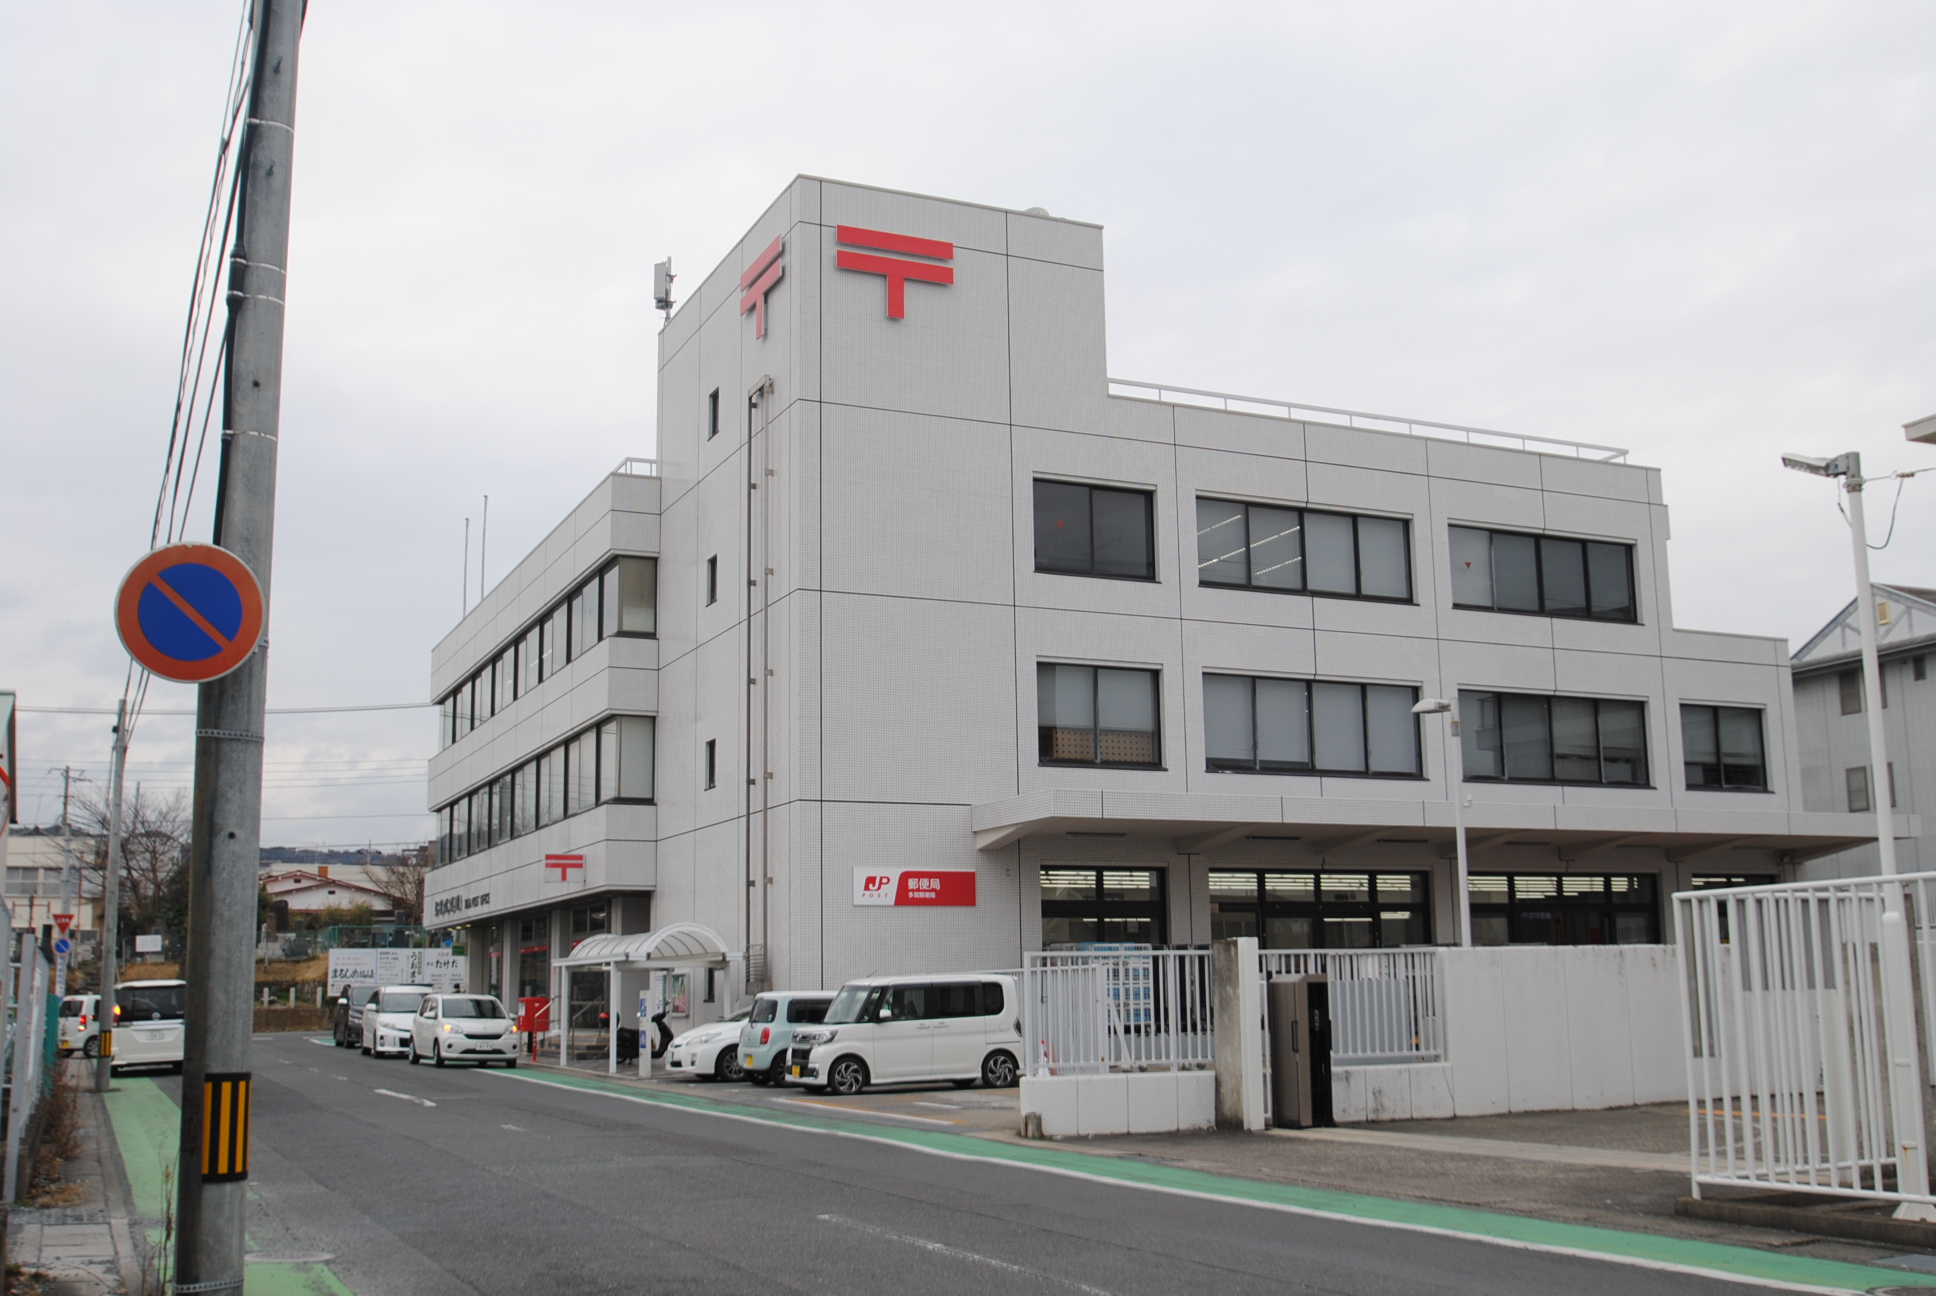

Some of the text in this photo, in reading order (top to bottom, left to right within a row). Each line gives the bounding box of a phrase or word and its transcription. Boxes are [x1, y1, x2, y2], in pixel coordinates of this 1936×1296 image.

[863, 876, 890, 891] JP
[908, 878, 940, 890] 郵便局
